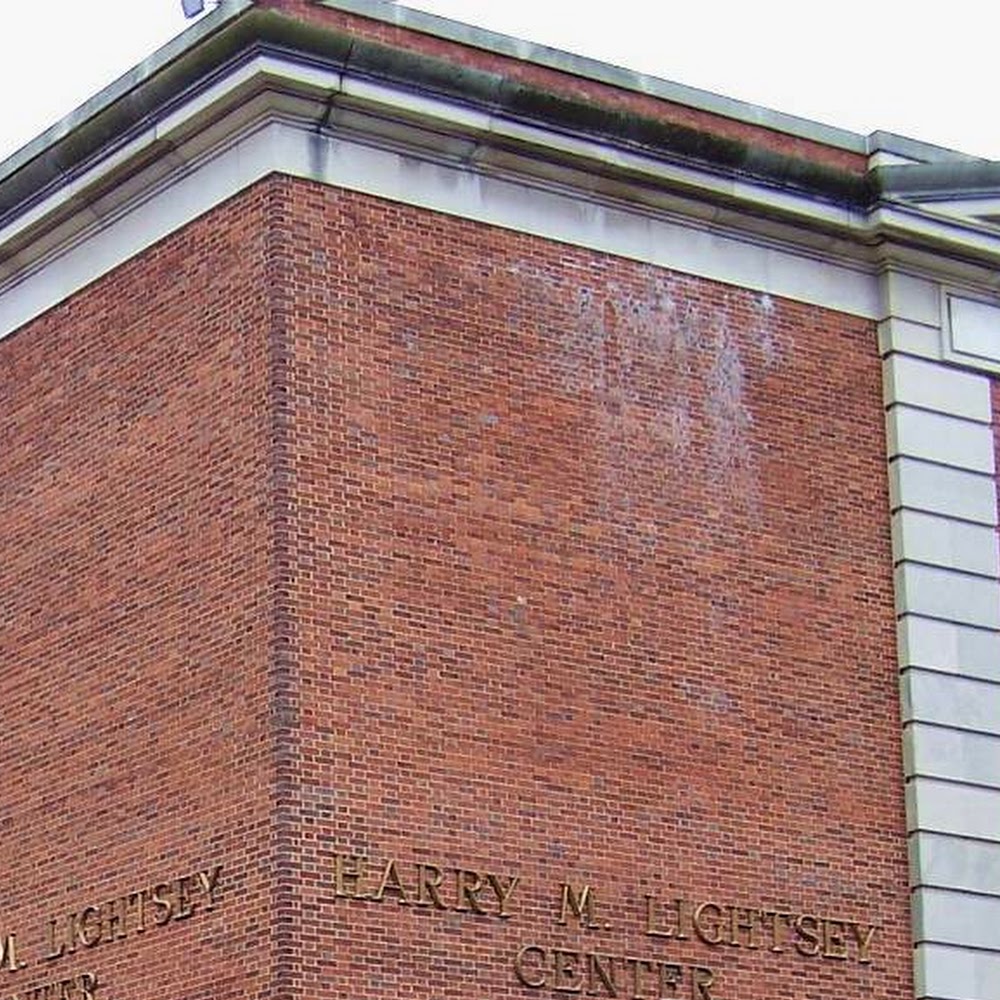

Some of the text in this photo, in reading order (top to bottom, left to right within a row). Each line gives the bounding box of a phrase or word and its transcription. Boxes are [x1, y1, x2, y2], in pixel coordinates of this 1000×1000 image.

[43, 865, 225, 961] LIGHTSEY
[332, 853, 878, 964] HARRY M. LIGHTSEY
